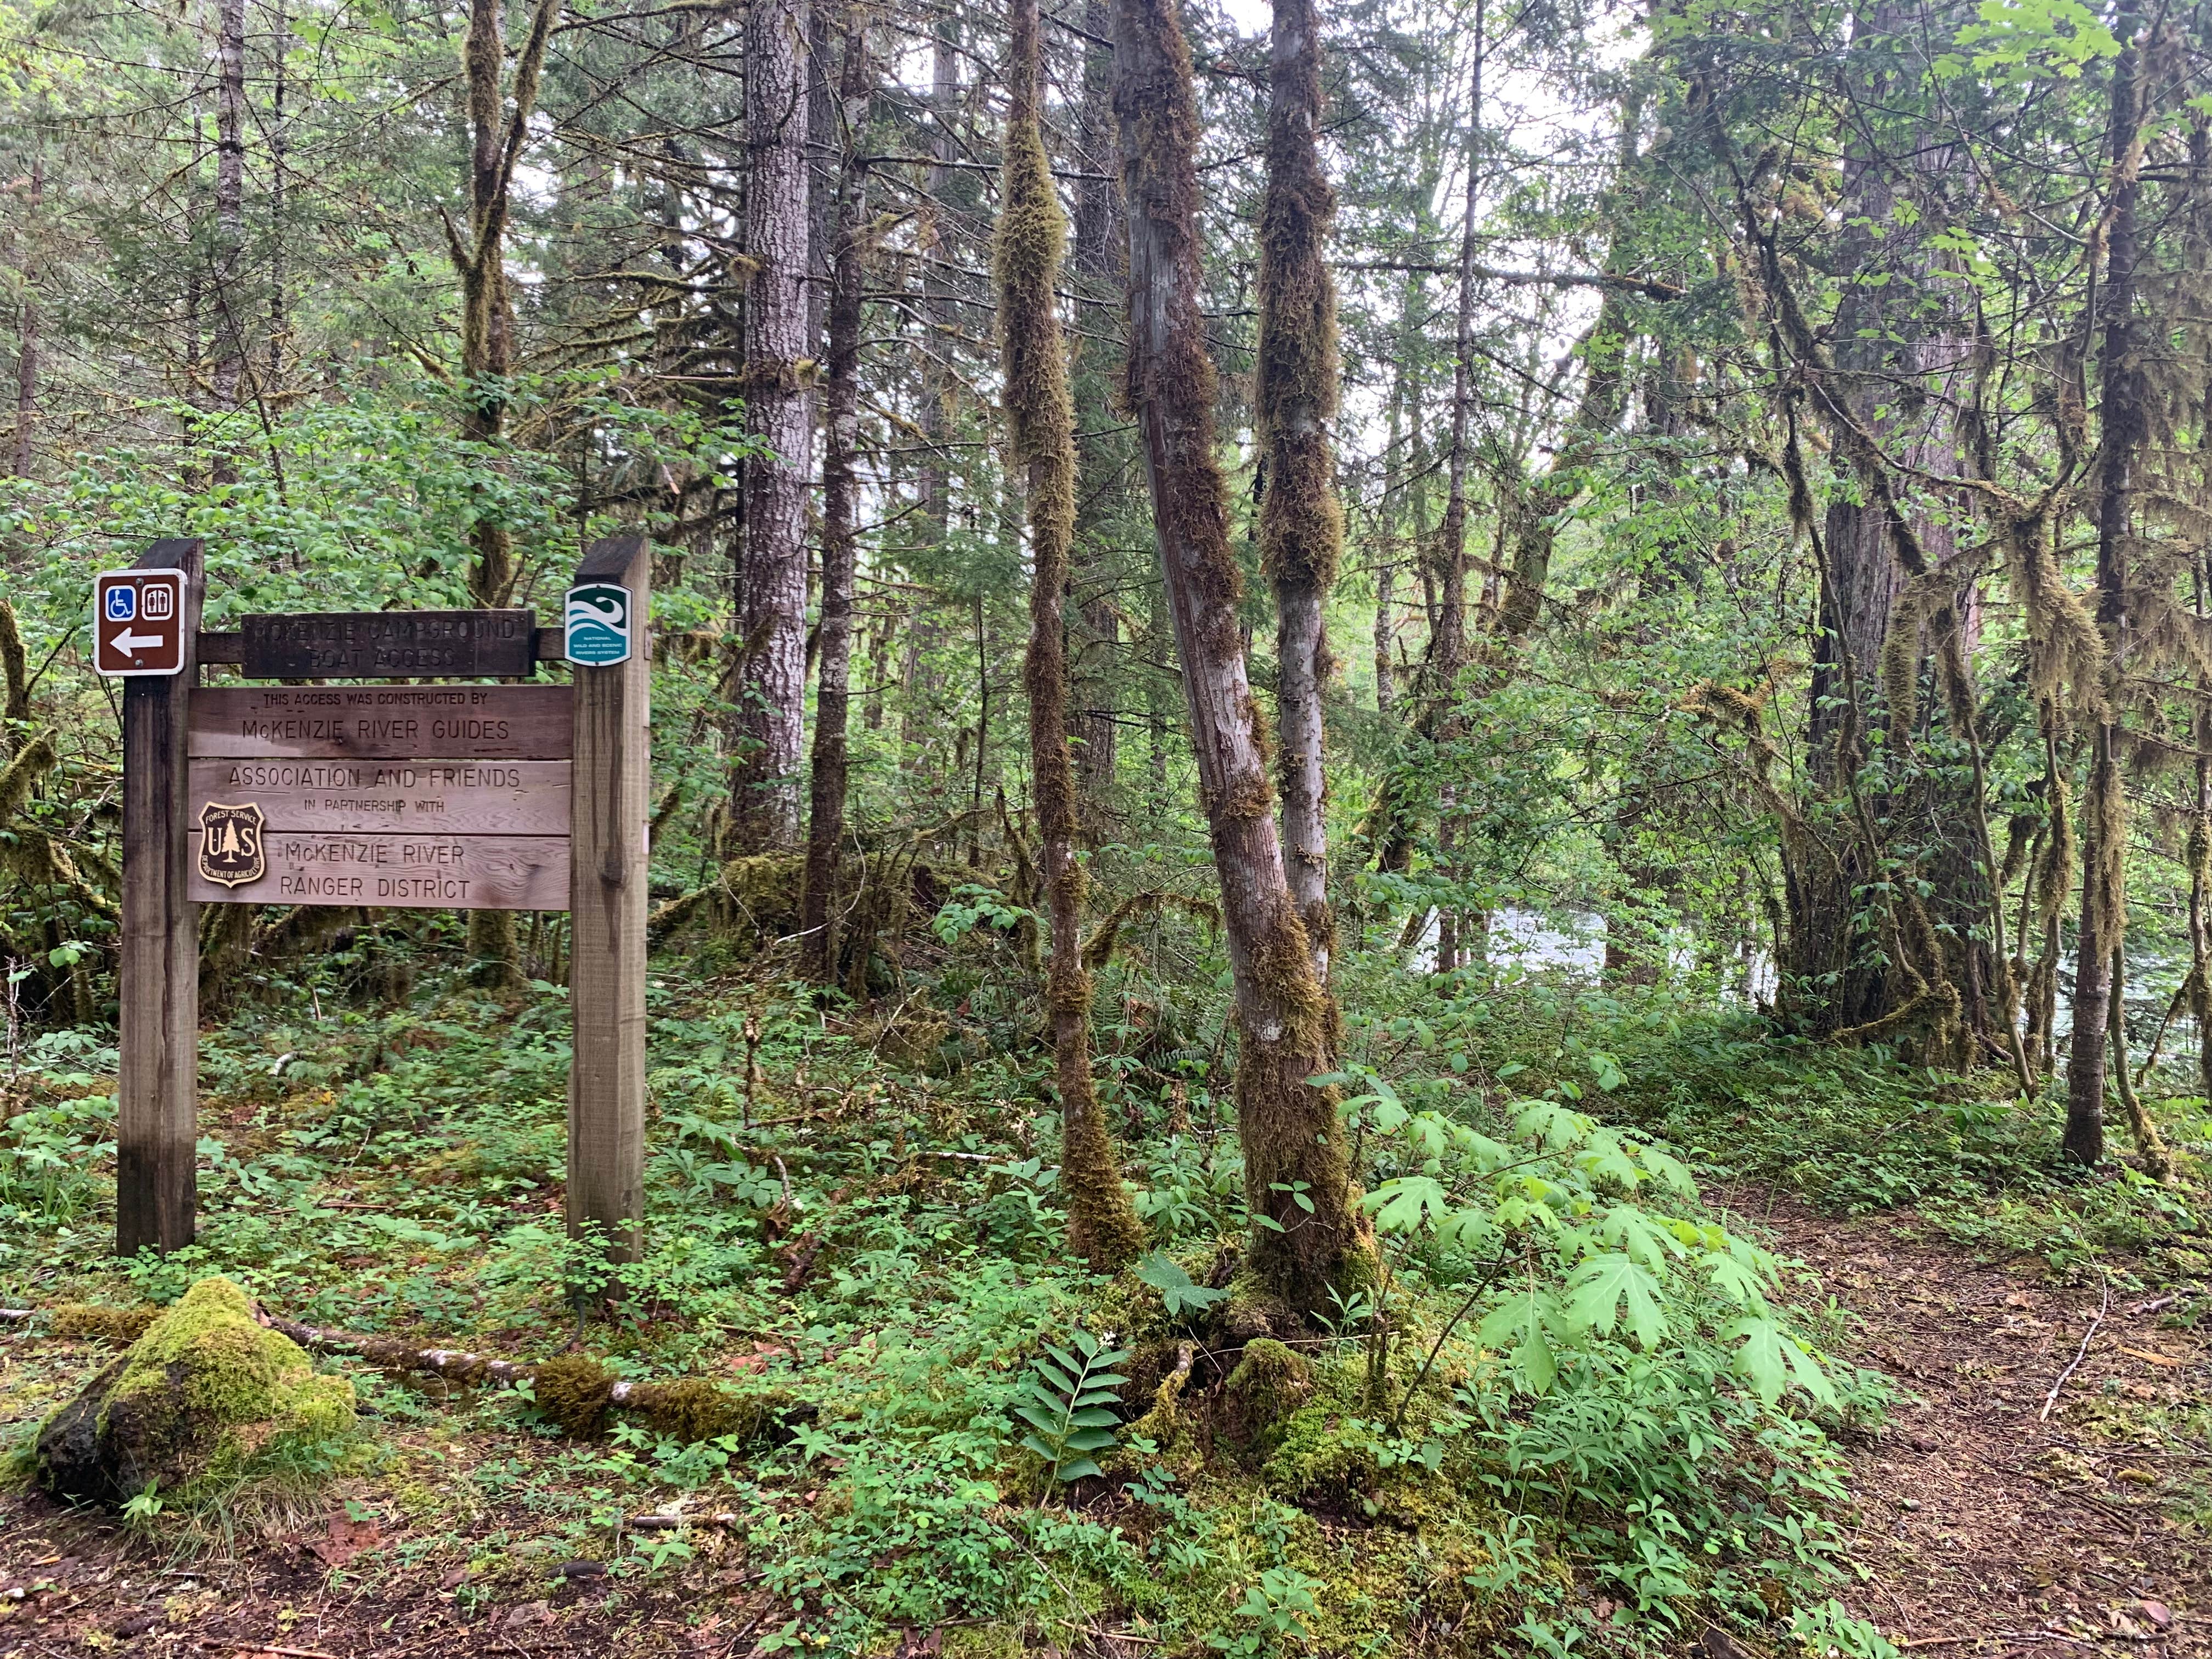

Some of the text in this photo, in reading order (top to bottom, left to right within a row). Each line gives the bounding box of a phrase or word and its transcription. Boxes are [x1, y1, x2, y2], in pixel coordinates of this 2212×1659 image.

[368, 619, 514, 639] CAMPGROUND
[310, 648, 454, 668] BOAT ACCESS
[263, 692, 488, 706] THIS ACCESS WAS CONSTRUCTED BY
[242, 719, 509, 740] McKENZIE RIVER GUIDES
[229, 767, 520, 788] ASSOCIATION AND FRIENDS
[304, 799, 444, 812] IN PARTNERSHIP WITH
[205, 810, 257, 826] FOREST SERVICE
[208, 827, 256, 857] U S
[286, 843, 464, 864] McKENZIE RIVER
[201, 855, 261, 879] DEPARTMENT OF AGRICULTURE
[280, 876, 470, 899] RANGER DISTRICT
